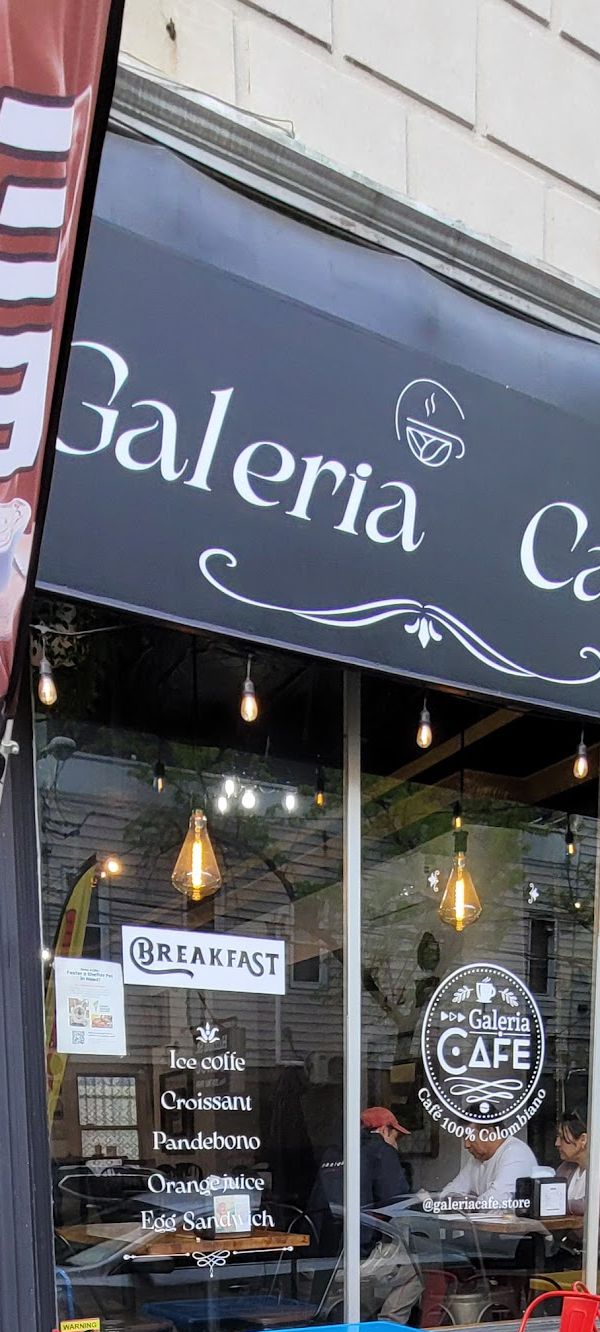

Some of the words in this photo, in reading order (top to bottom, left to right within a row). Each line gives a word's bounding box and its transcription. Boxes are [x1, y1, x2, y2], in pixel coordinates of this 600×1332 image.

[55, 340, 426, 552] Galeria
[129, 936, 280, 979] BREAKFAST
[468, 1008, 531, 1032] Galeria
[169, 1049, 197, 1069] Ice
[201, 1051, 246, 1071] coffe
[437, 1027, 531, 1075] CAFE
[160, 1090, 253, 1111] Croissant
[417, 1087, 442, 1122] Café
[440, 1117, 476, 1142] 100%
[479, 1088, 546, 1142] Colombiano
[152, 1131, 261, 1150] Pandebono
[147, 1173, 220, 1196] Orange
[422, 1196, 531, 1214] @galeriacafe.store
[141, 1210, 177, 1233] Egg
[62, 1322, 97, 1331] WARNING
